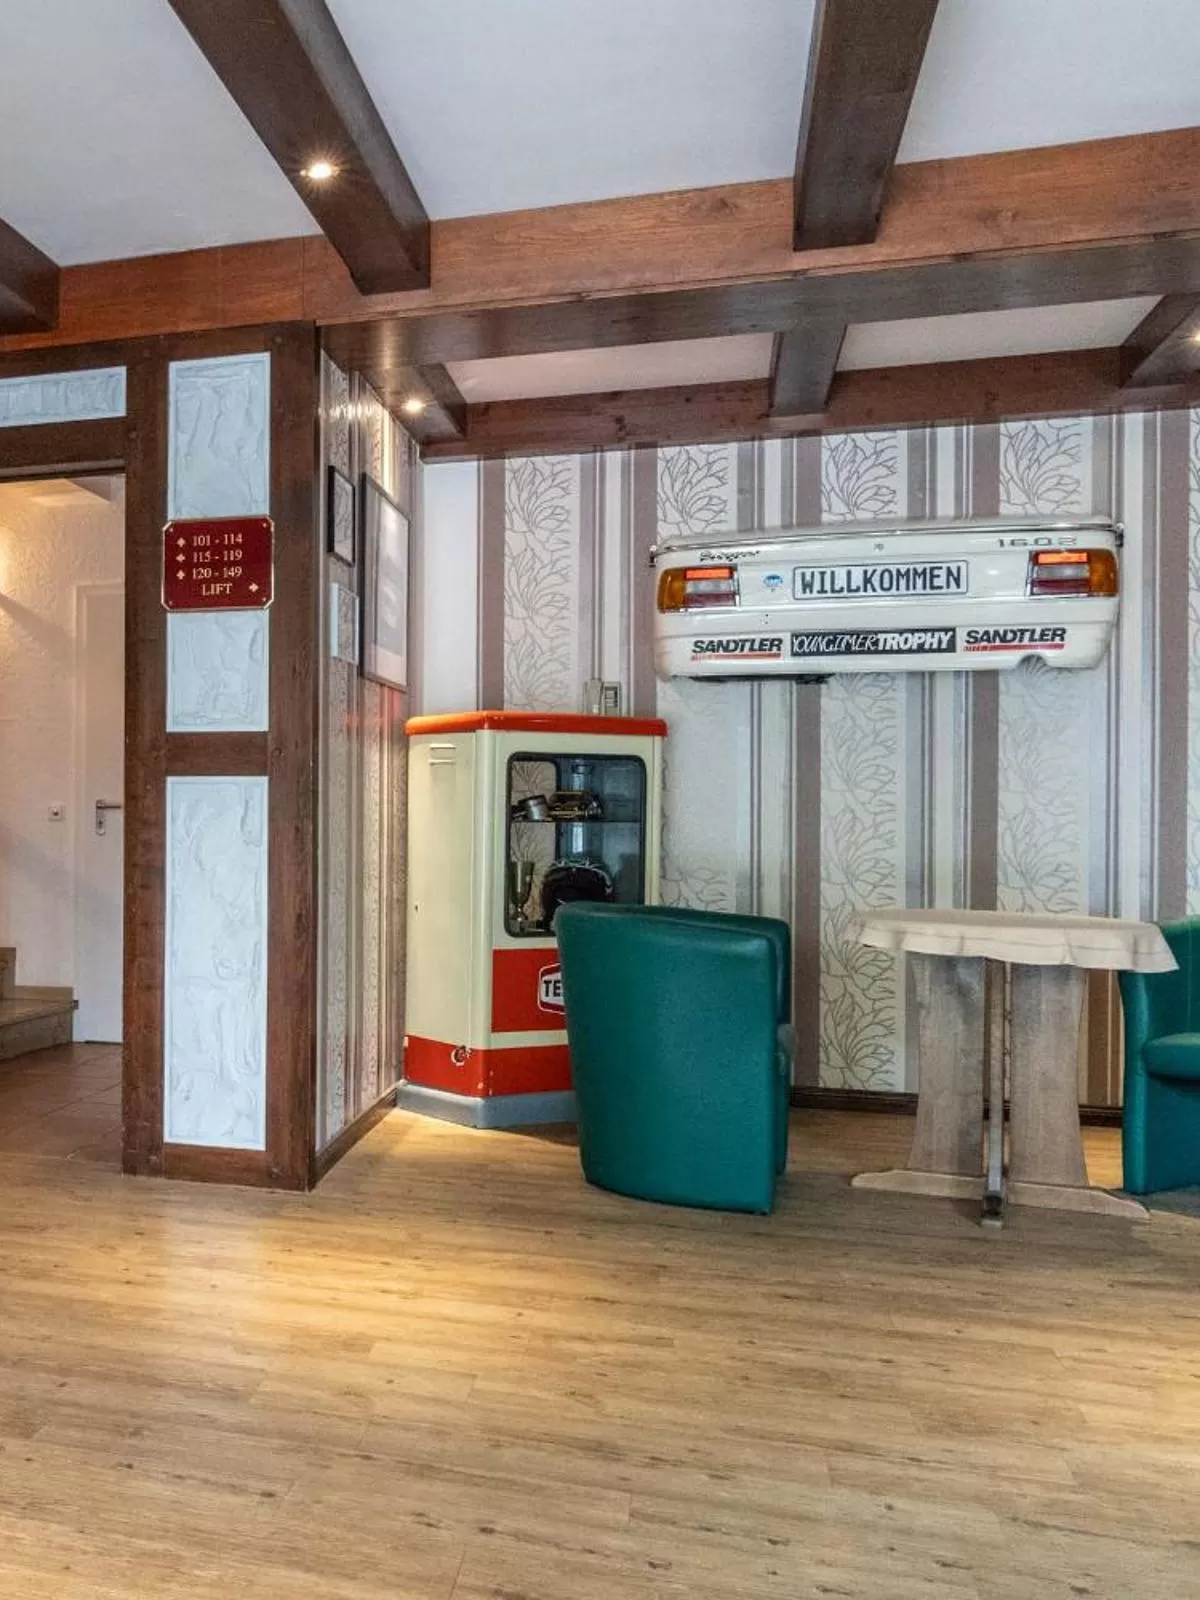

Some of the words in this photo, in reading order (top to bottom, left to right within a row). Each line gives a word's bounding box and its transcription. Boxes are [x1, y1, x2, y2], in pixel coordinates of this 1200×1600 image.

[192, 535, 211, 547] 101
[223, 533, 243, 545] 114
[192, 550, 212, 563] 115
[223, 549, 243, 561] 119
[192, 567, 212, 579] 120
[223, 566, 243, 578] 149
[800, 565, 962, 595] WILLKOMMEN
[202, 583, 233, 596] LIFT
[964, 626, 1067, 645] SANDTLER
[691, 637, 783, 653] SANDTLER
[543, 979, 562, 998] TE
